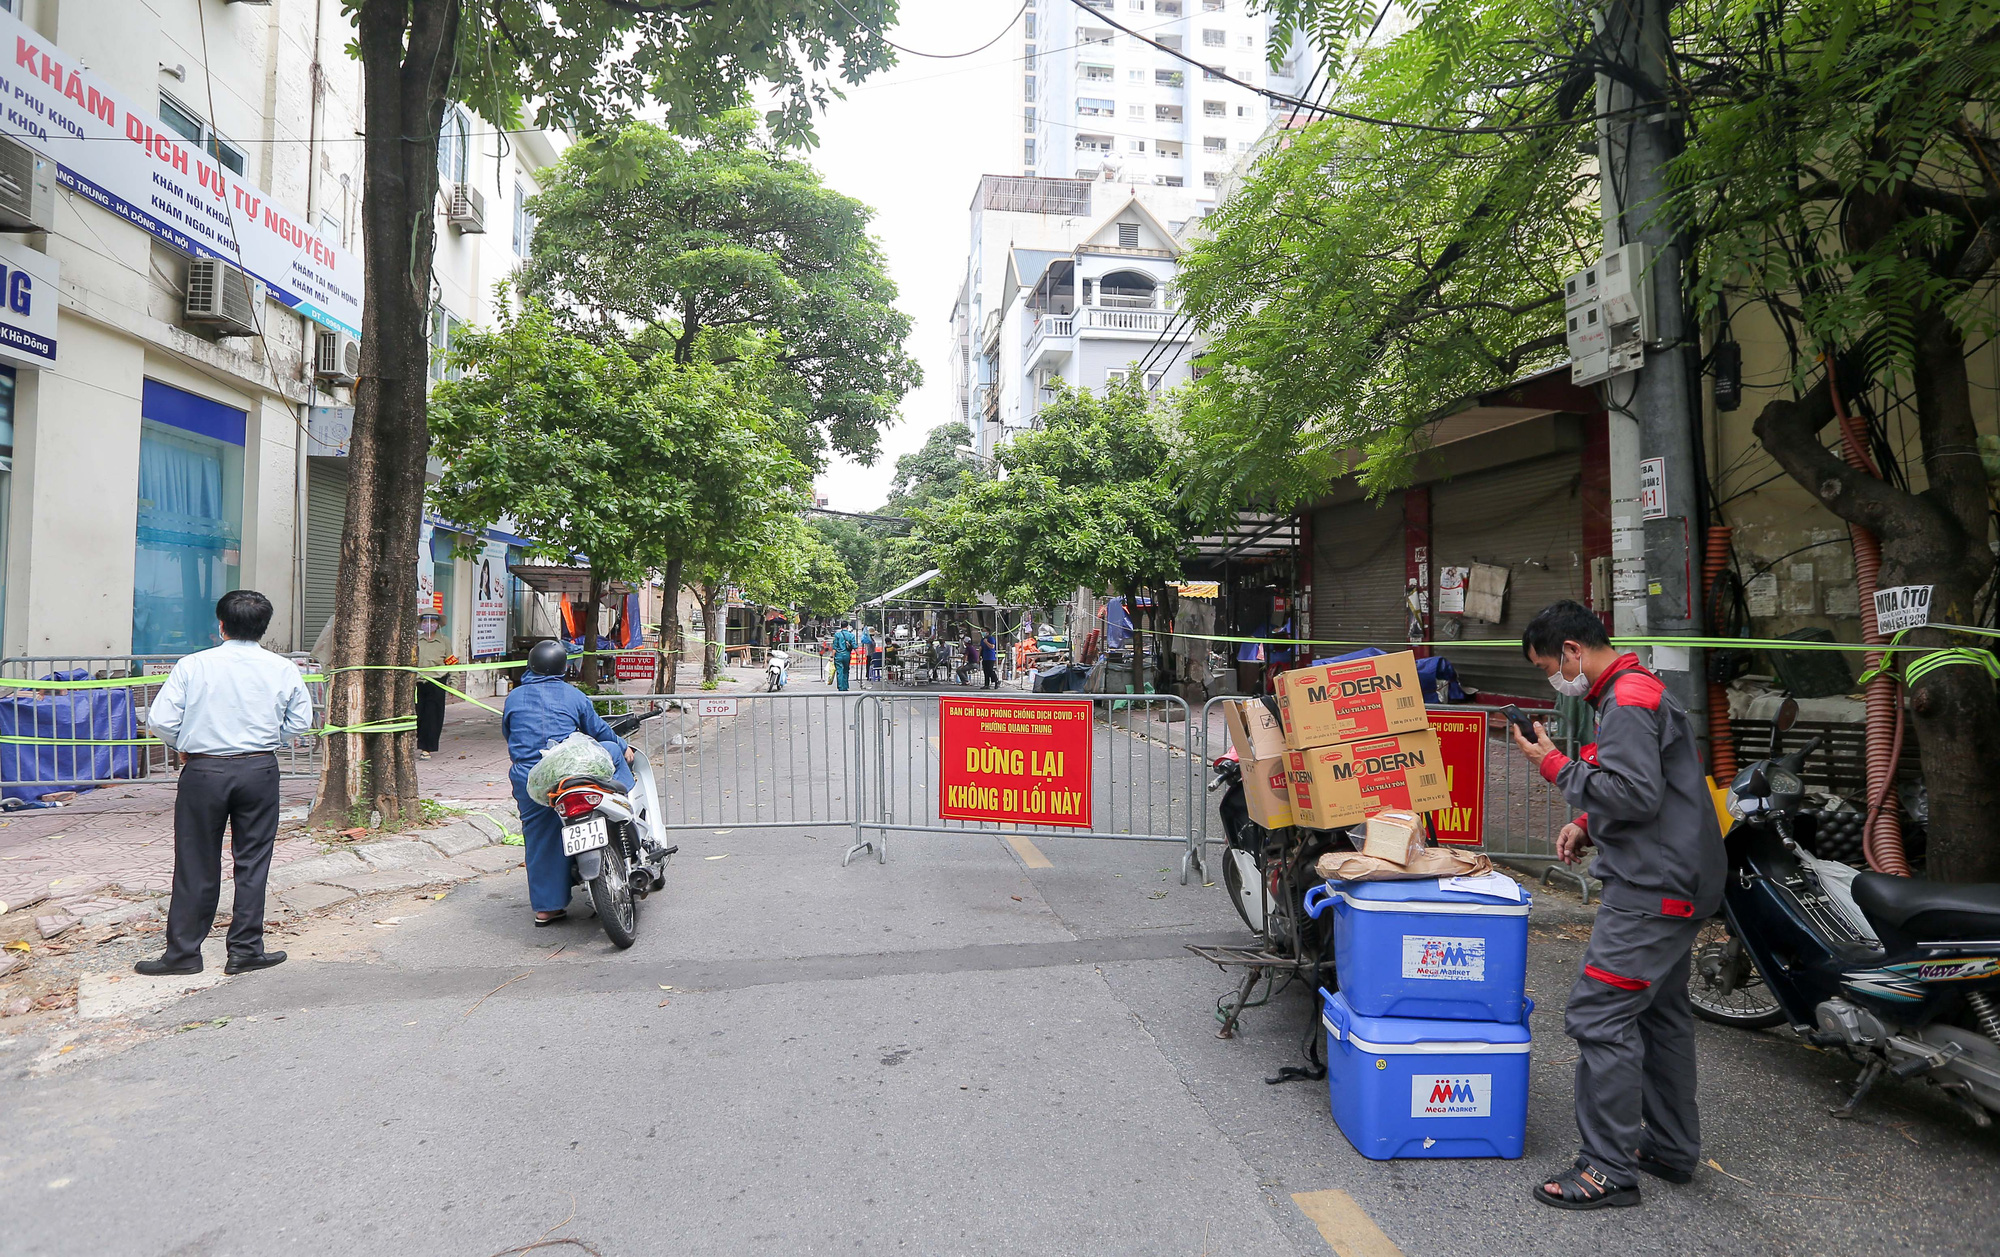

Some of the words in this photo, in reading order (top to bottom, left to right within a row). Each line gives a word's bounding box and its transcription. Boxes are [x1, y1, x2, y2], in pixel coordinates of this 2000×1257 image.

[8, 108, 47, 142] KHOA
[15, 86, 44, 116] PHỤ
[49, 108, 85, 141] KHOA
[16, 35, 115, 128] KHÁM
[126, 112, 188, 175] DỊCH
[197, 160, 225, 201] VỤ
[233, 184, 261, 222] TỰ
[265, 206, 335, 270] NGUYỆN
[76, 180, 110, 208] TRUNG
[116, 202, 129, 217] HÀ
[131, 209, 155, 231] ĐÔNG
[175, 235, 189, 250] NỘI
[152, 172, 183, 199] KHÁM
[186, 193, 203, 211] NỘI
[206, 205, 231, 228] KHOA
[151, 194, 182, 221] KHÁM
[185, 214, 214, 240] NGOẠI
[292, 260, 313, 280] KHÁM
[315, 274, 325, 288] TAI
[292, 277, 313, 297] KHÁM
[1876, 591, 1898, 614] MUA
[1901, 586, 1929, 609] ÔTÔ
[1307, 673, 1402, 702] MODERN
[949, 707, 963, 716] BAN
[976, 708, 989, 719] ĐẠO
[990, 707, 1012, 719] PHÒNG
[1013, 707, 1035, 720] CHỐNG
[1036, 710, 1052, 722] DỊCH
[1053, 711, 1073, 720] COVID
[1074, 711, 1085, 720] -19
[980, 720, 1007, 732] PHƯỜNG
[1007, 723, 1030, 733] QUANG
[1031, 724, 1052, 734] TRUNG
[1443, 723, 1464, 732] COVID
[1465, 724, 1478, 732] -19
[966, 742, 1024, 776] DỪNG
[1031, 750, 1064, 782] LẠI
[1332, 750, 1425, 780] MODERN
[948, 782, 999, 811] KHÔNG
[1003, 788, 1018, 812] ĐI
[1023, 782, 1046, 814] LỐI
[1051, 787, 1082, 815] NÀY
[569, 821, 599, 840] 29-T1
[1438, 802, 1473, 832] NÀY
[567, 832, 605, 853] 607.76
